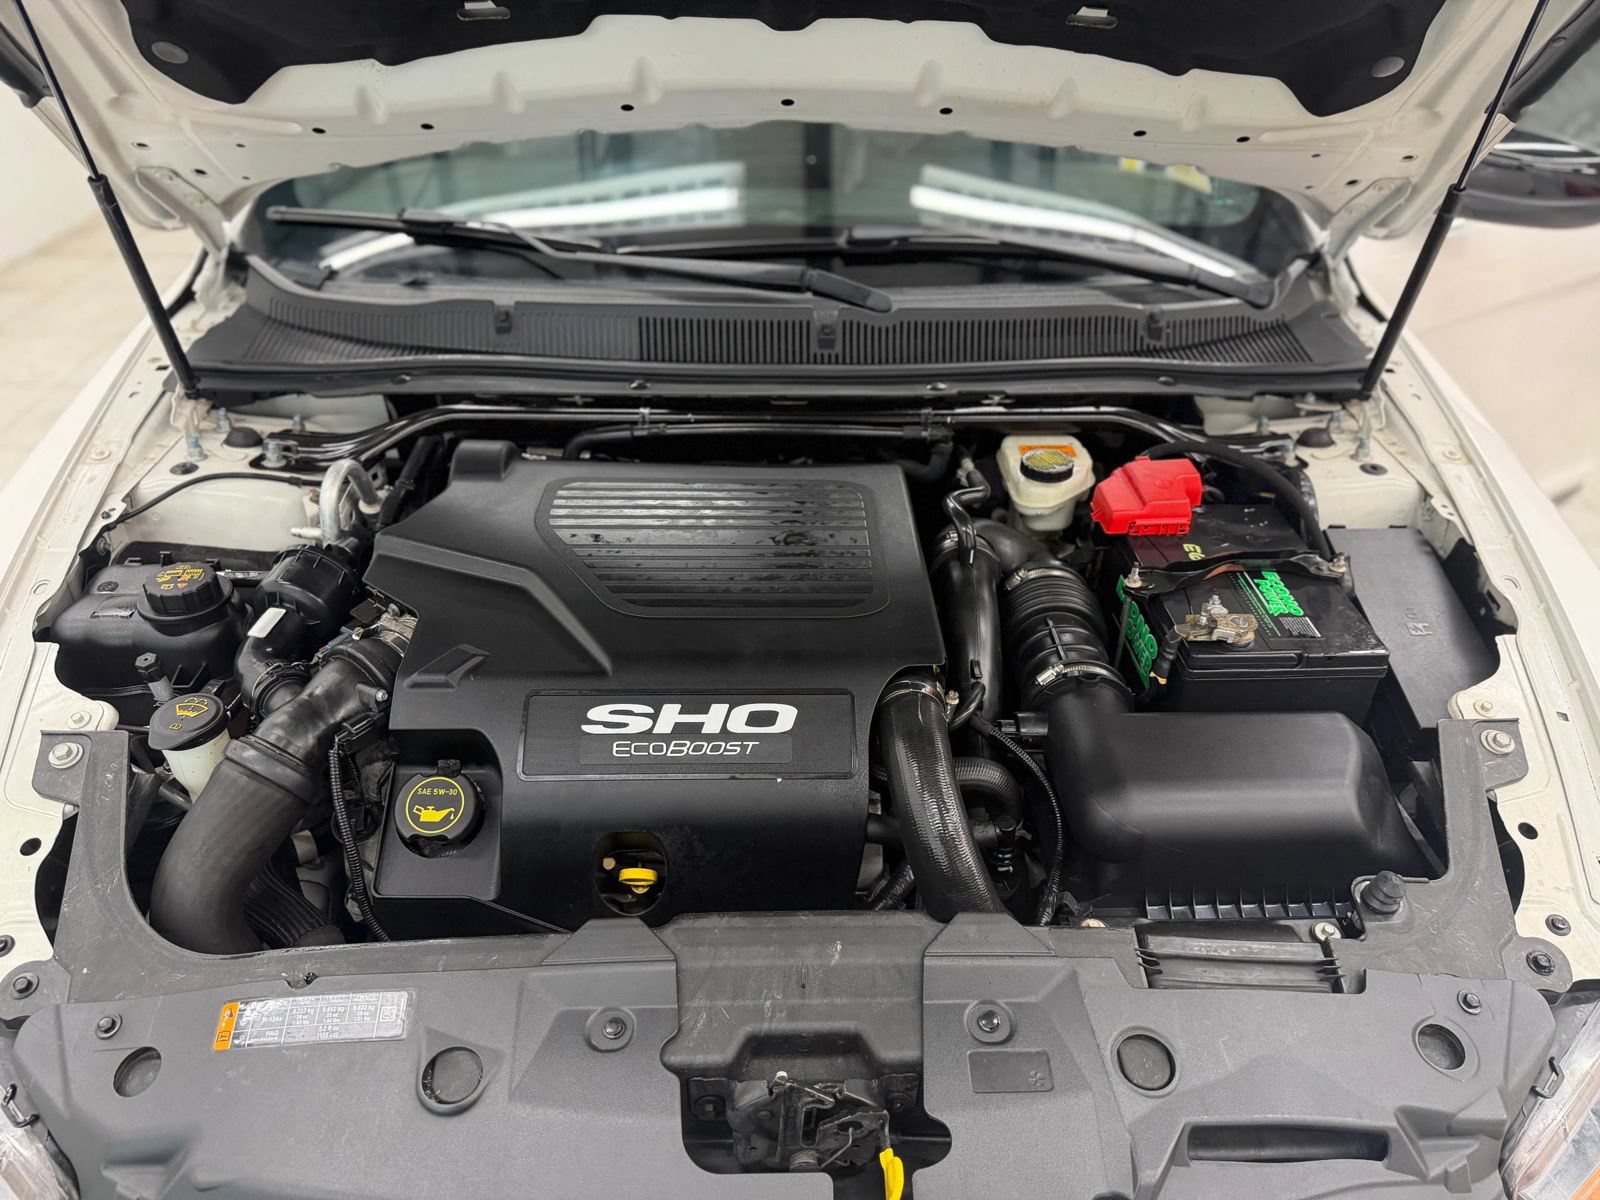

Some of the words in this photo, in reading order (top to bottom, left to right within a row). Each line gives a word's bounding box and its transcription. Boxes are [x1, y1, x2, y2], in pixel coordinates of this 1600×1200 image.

[1254, 579, 1289, 616] POWER
[1261, 571, 1304, 616] ECONO
[581, 703, 798, 734] SHO
[417, 787, 432, 795] SAE
[433, 787, 458, 796] 5W-30
